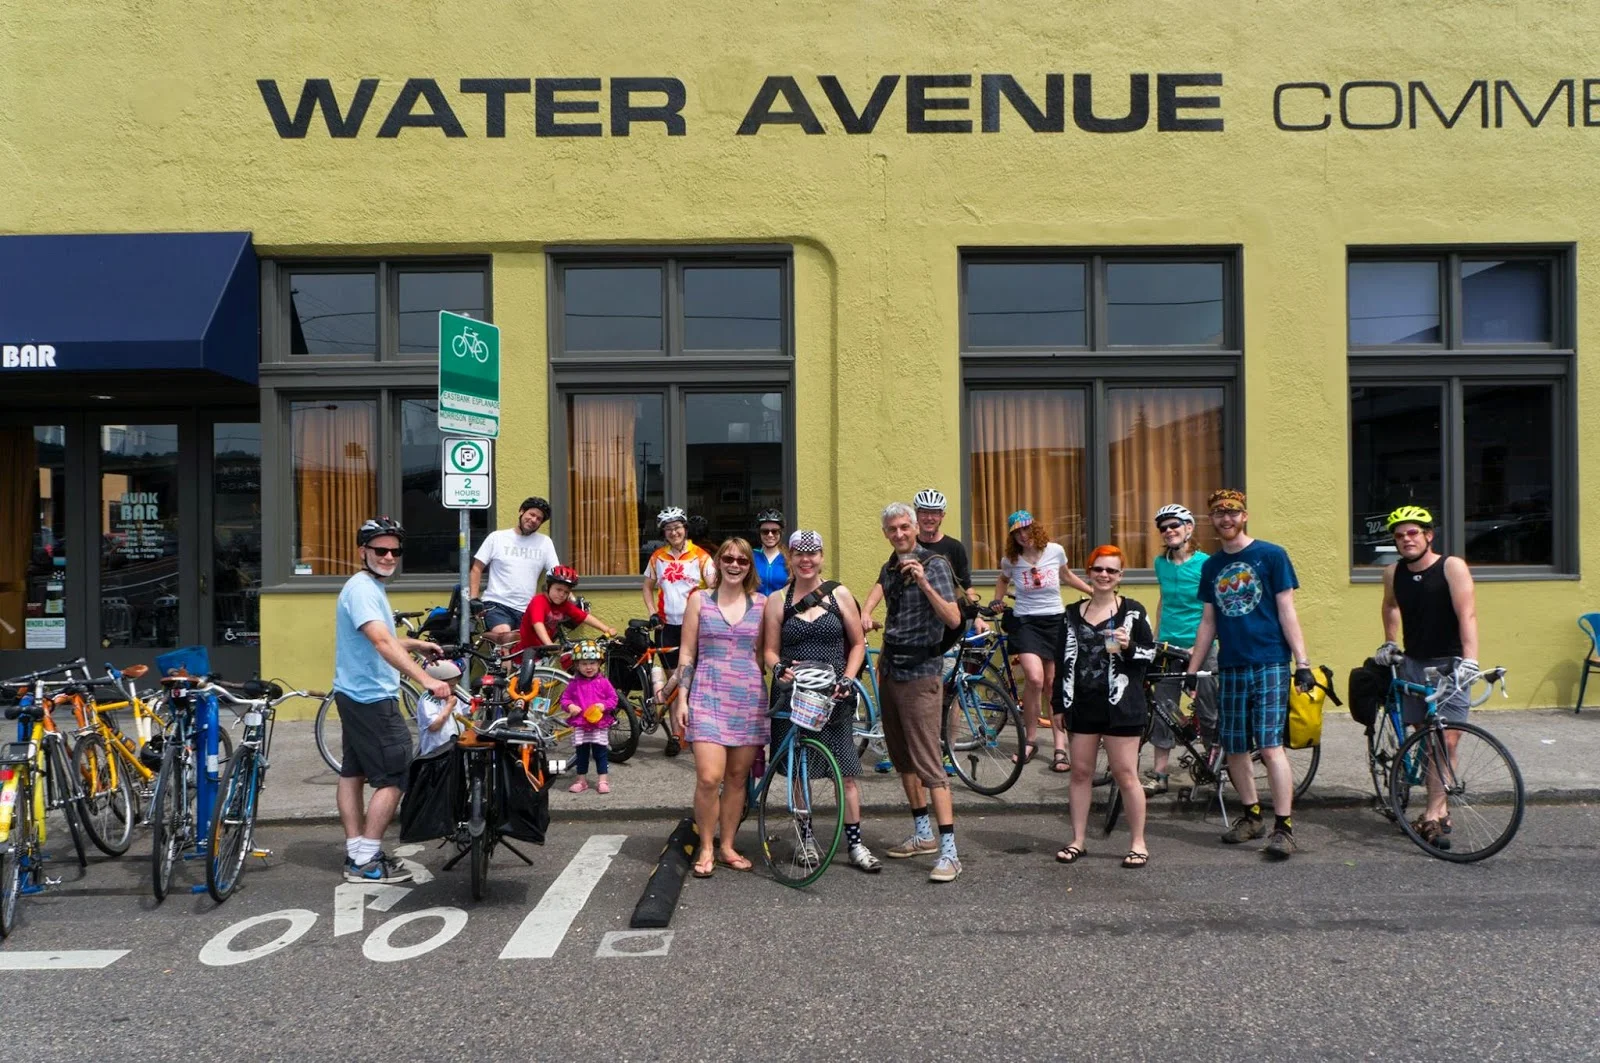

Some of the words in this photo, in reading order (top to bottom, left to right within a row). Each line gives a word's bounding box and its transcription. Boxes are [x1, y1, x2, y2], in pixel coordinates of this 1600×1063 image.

[256, 77, 687, 139] WATER
[735, 73, 1225, 136] AVENUE
[2, 344, 57, 368] BAR
[443, 391, 470, 403] EASTBANK
[472, 397, 500, 410] ESPLANADE
[440, 411, 467, 422] MORRISON
[468, 415, 486, 426] BRIDGE
[464, 478, 472, 489] 2
[454, 489, 481, 497] HOURS
[121, 504, 159, 520] BAR
[504, 546, 542, 561] TAHITI
